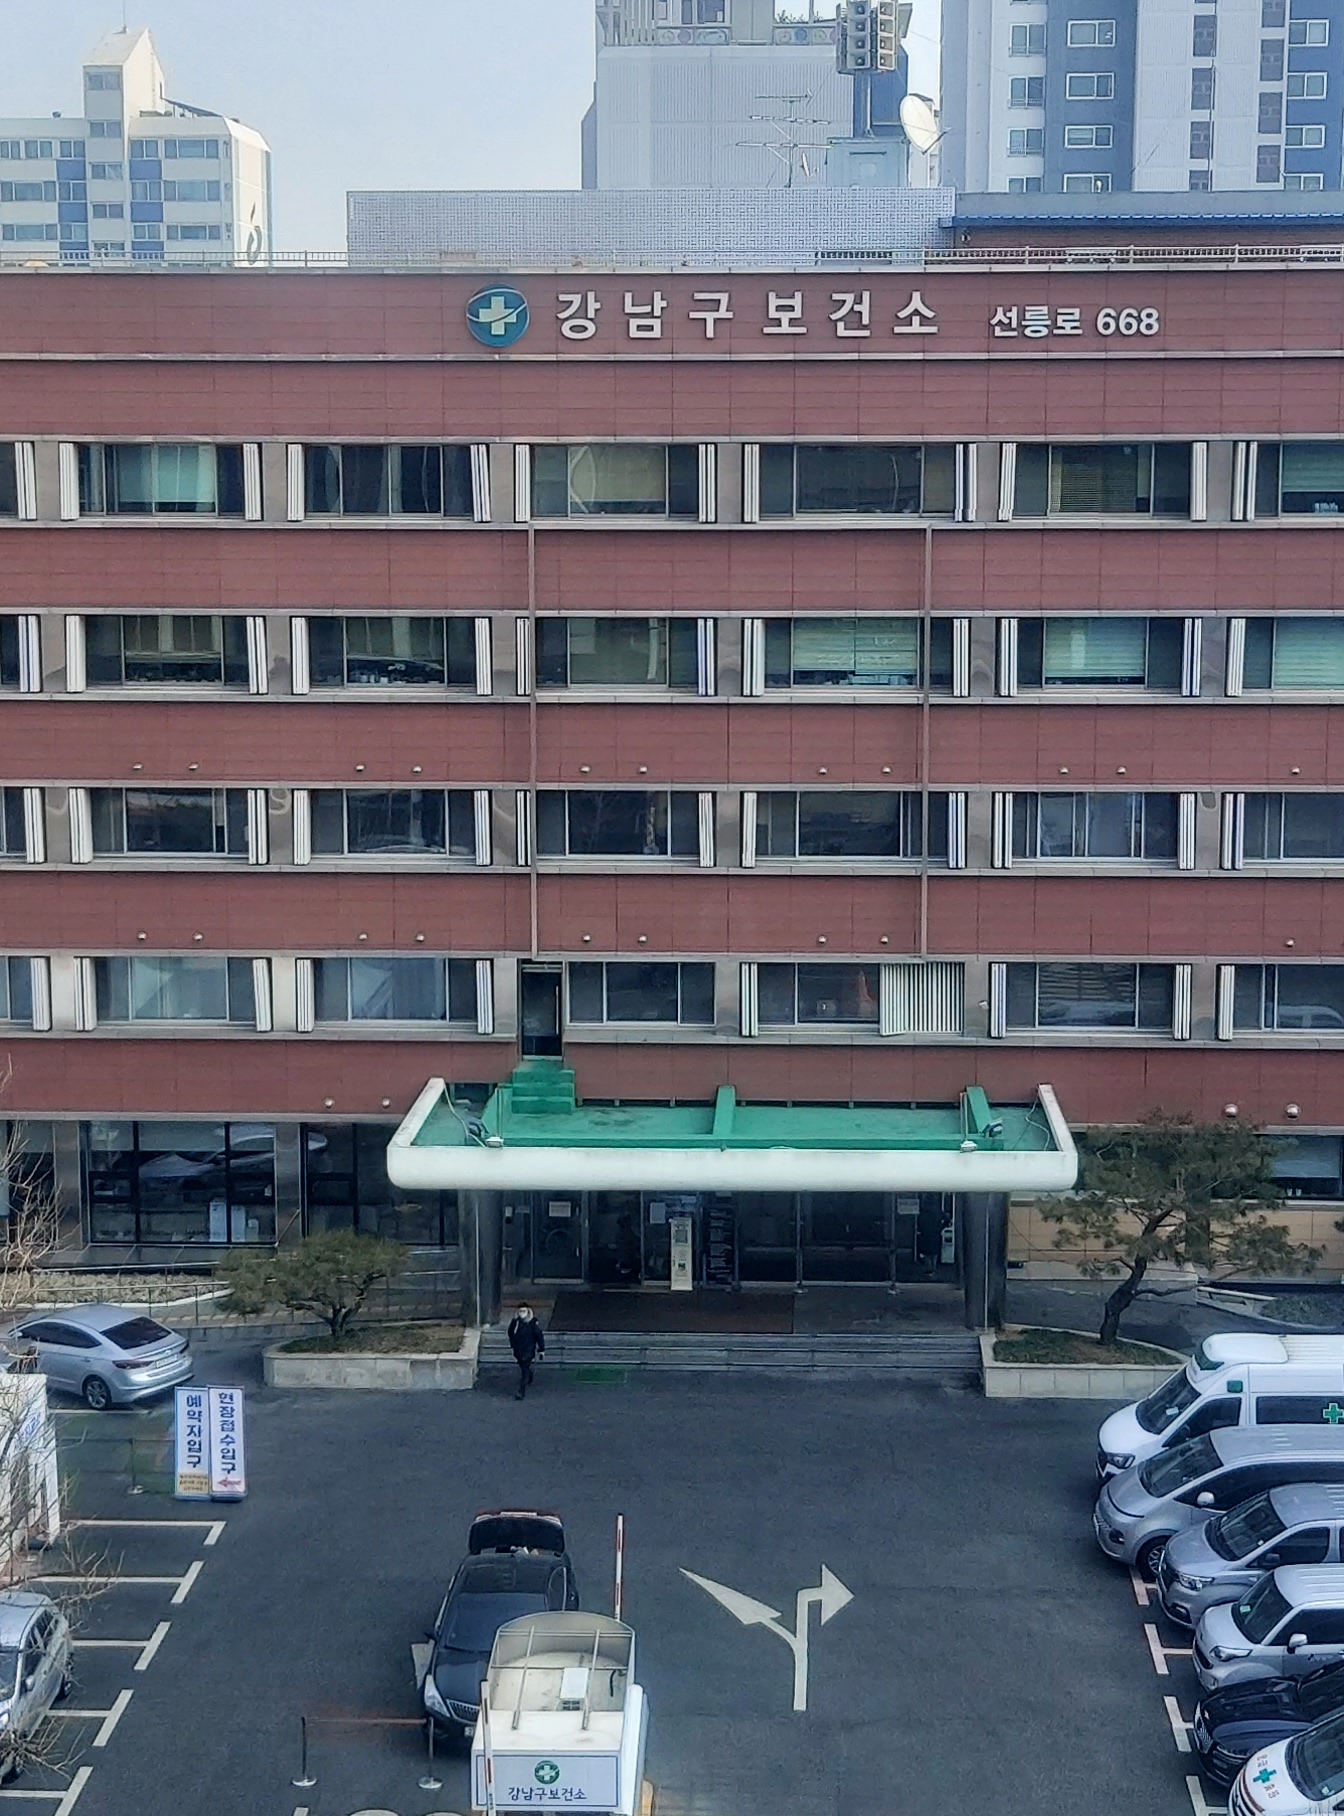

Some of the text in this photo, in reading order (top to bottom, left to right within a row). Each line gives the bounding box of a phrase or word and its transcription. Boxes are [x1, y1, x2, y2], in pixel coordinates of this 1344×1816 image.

[989, 305, 1160, 338] 선릉로 668
[219, 1393, 236, 1474] 현장접수입구
[508, 1787, 587, 1801] 강남구보건소
